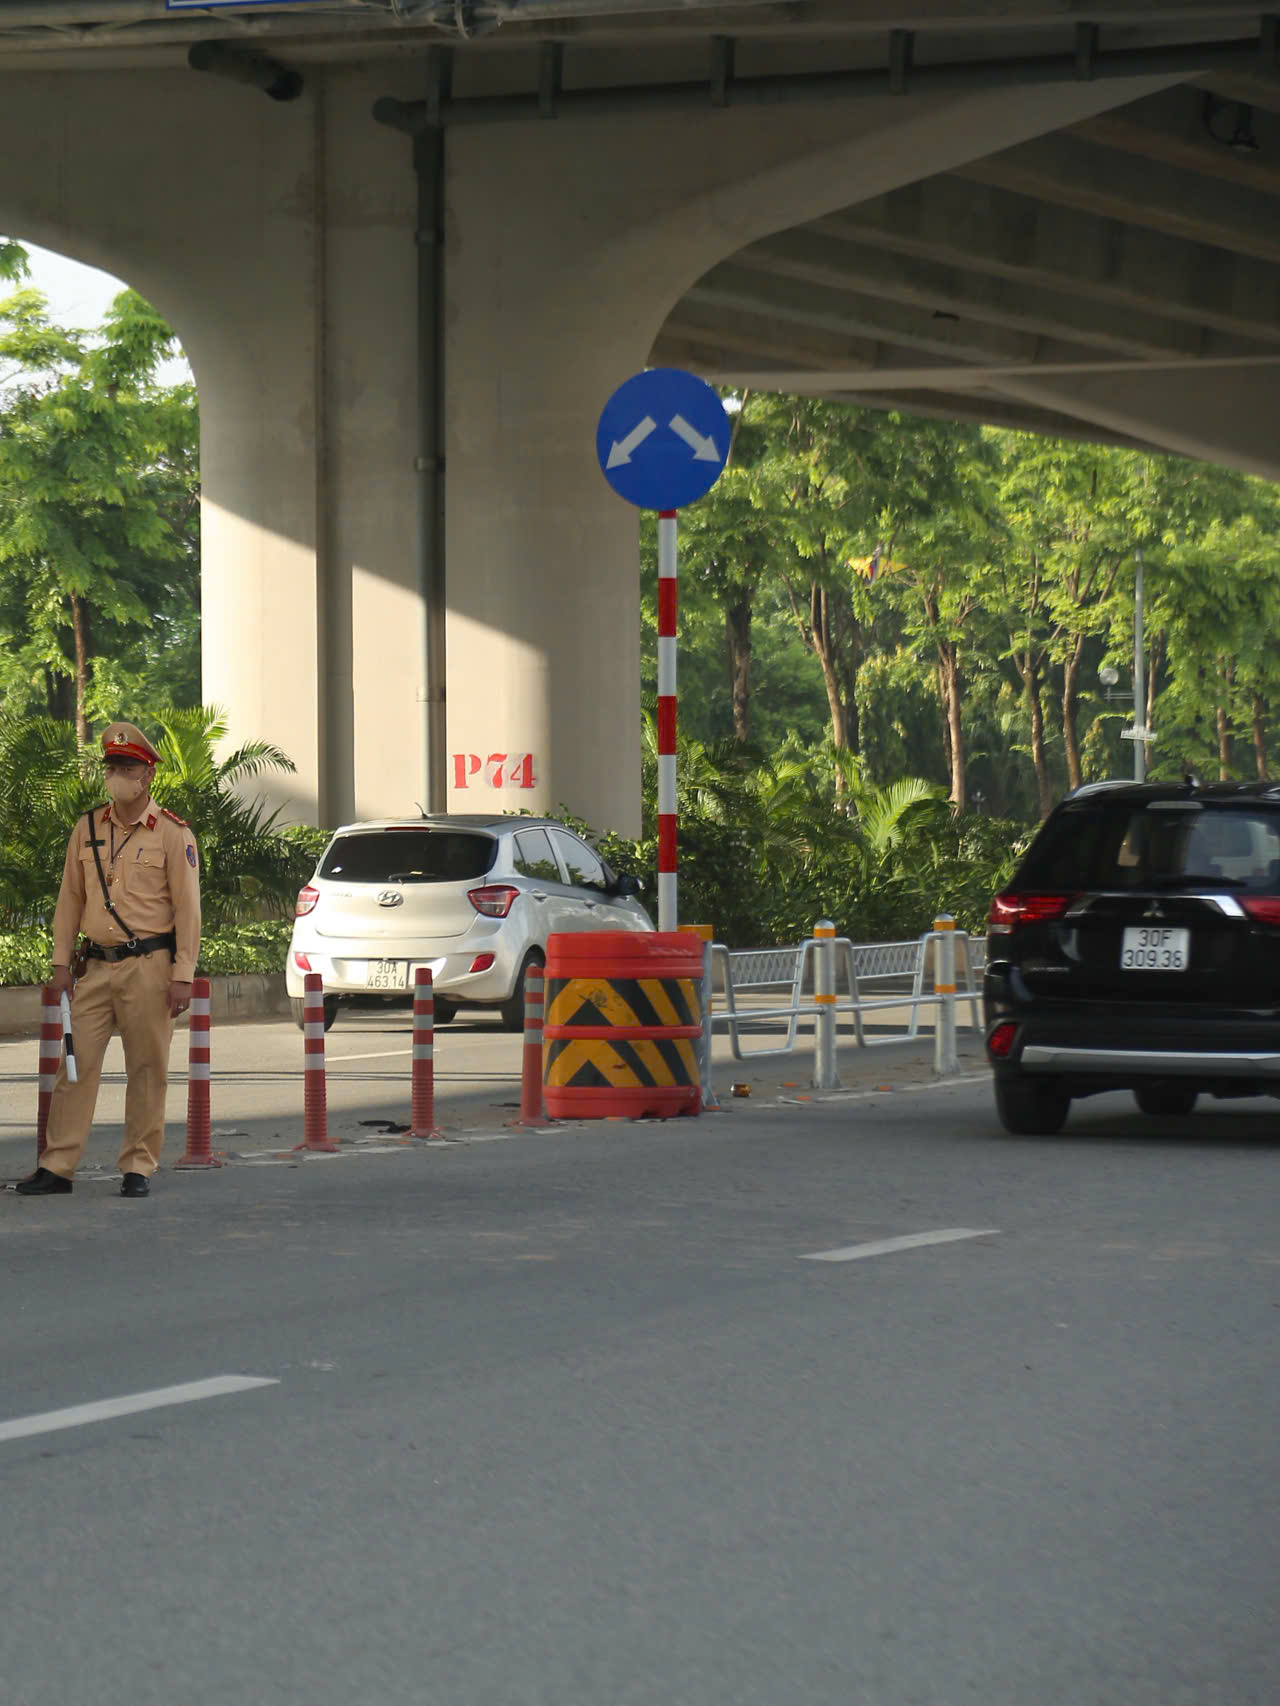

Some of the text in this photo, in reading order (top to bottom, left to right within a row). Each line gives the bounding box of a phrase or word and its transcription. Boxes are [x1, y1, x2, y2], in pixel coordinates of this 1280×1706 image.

[452, 753, 537, 788] P74
[1138, 929, 1173, 947] 30F
[376, 960, 397, 974] 30A
